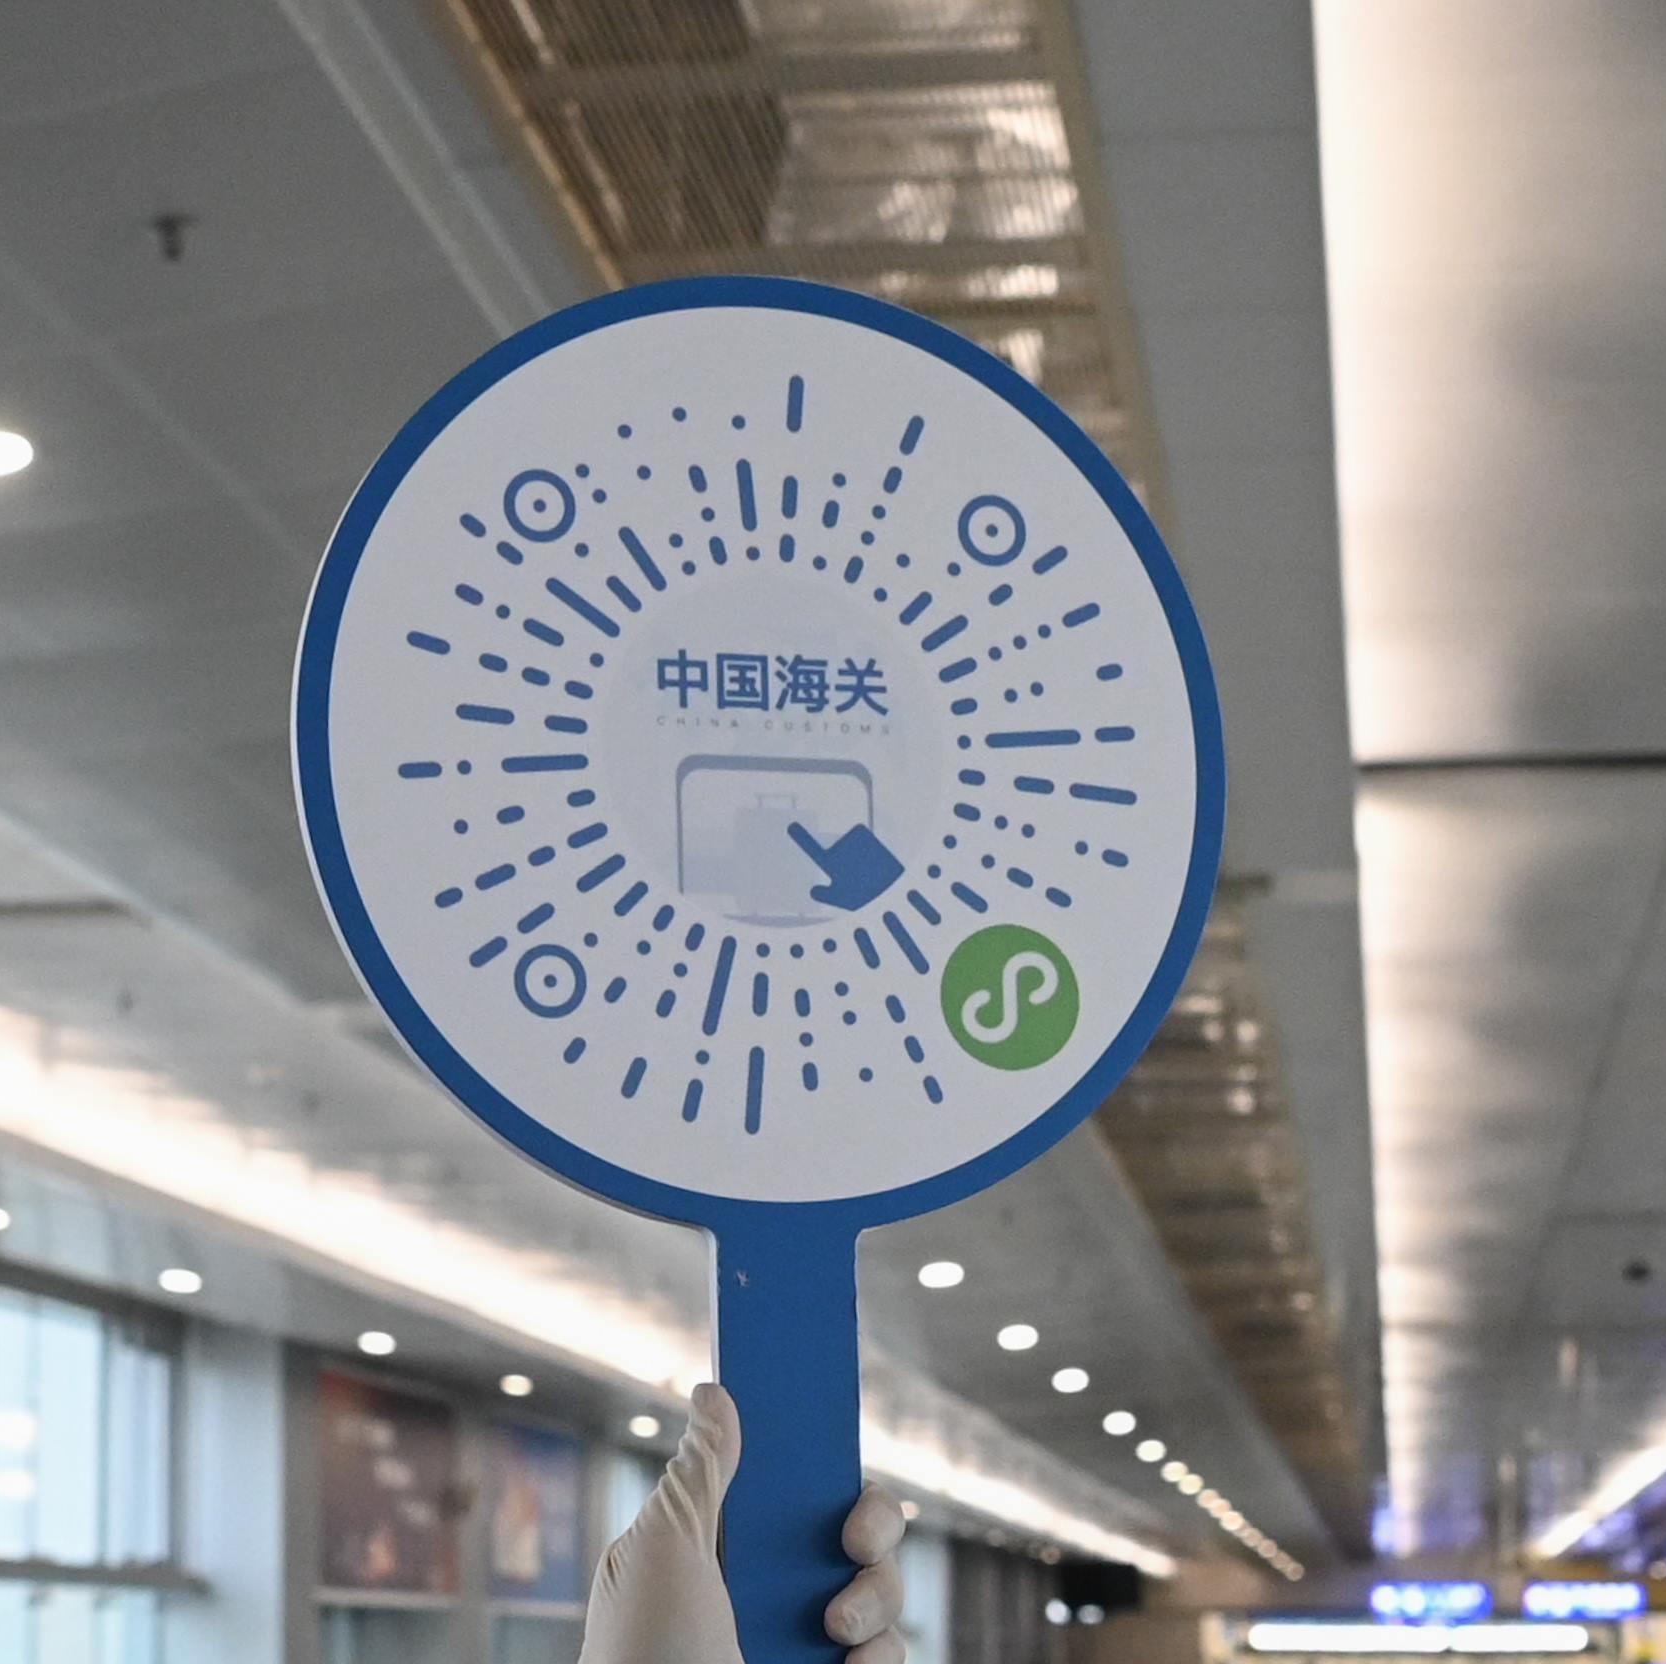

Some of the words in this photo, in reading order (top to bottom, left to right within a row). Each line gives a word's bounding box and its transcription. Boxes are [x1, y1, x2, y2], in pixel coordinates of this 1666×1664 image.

[657, 649, 889, 716] 中国海关
[656, 715, 739, 728] CHINA
[763, 720, 890, 736] CUSTOMS
